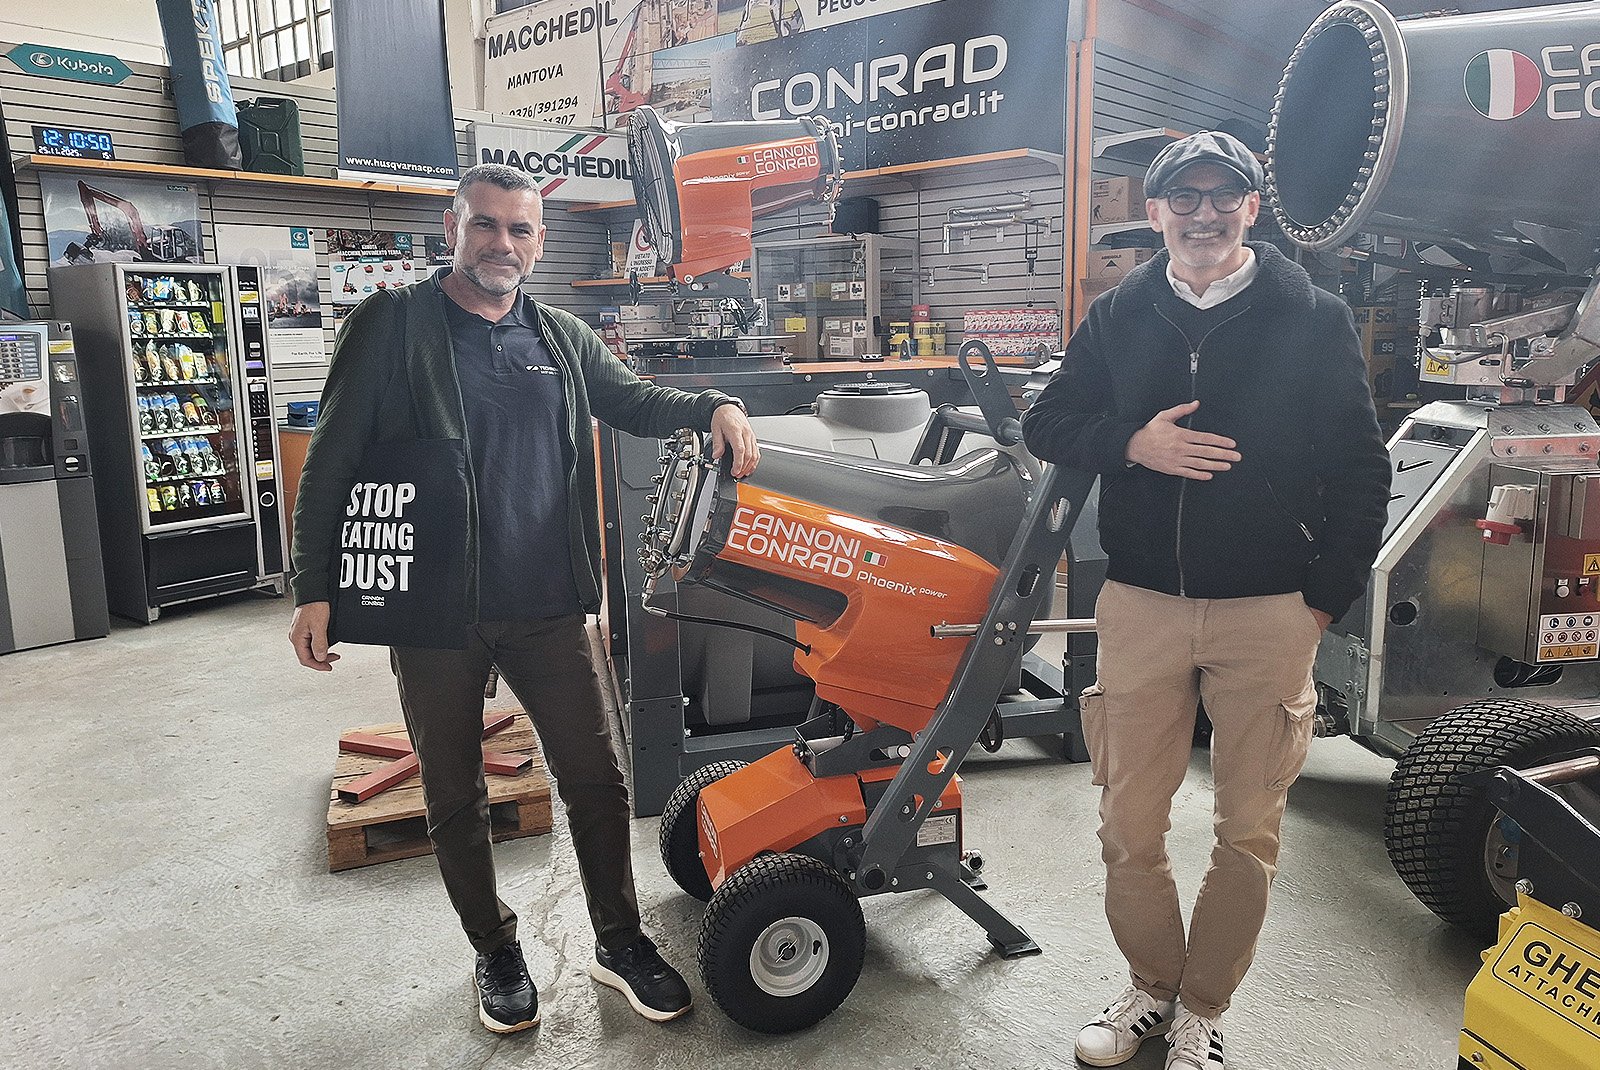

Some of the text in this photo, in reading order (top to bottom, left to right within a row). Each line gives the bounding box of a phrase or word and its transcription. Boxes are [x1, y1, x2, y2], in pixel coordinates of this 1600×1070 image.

[488, 1, 617, 59] MACCHEDIL
[57, 56, 113, 76] Kubota
[507, 64, 563, 90] MANTOVA
[752, 35, 1008, 121] CONRAD
[345, 156, 455, 176] www.husqvarnacp.com
[482, 148, 632, 181] MACCHEDIL
[754, 144, 817, 163] CANNONI
[755, 156, 819, 174] CONRAD
[346, 482, 416, 518] STOP
[341, 521, 414, 551] EATING
[732, 507, 861, 559] CANNONI
[727, 528, 854, 578] CONRAD
[339, 553, 414, 591] DUST
[856, 570, 948, 600] Phoenix power
